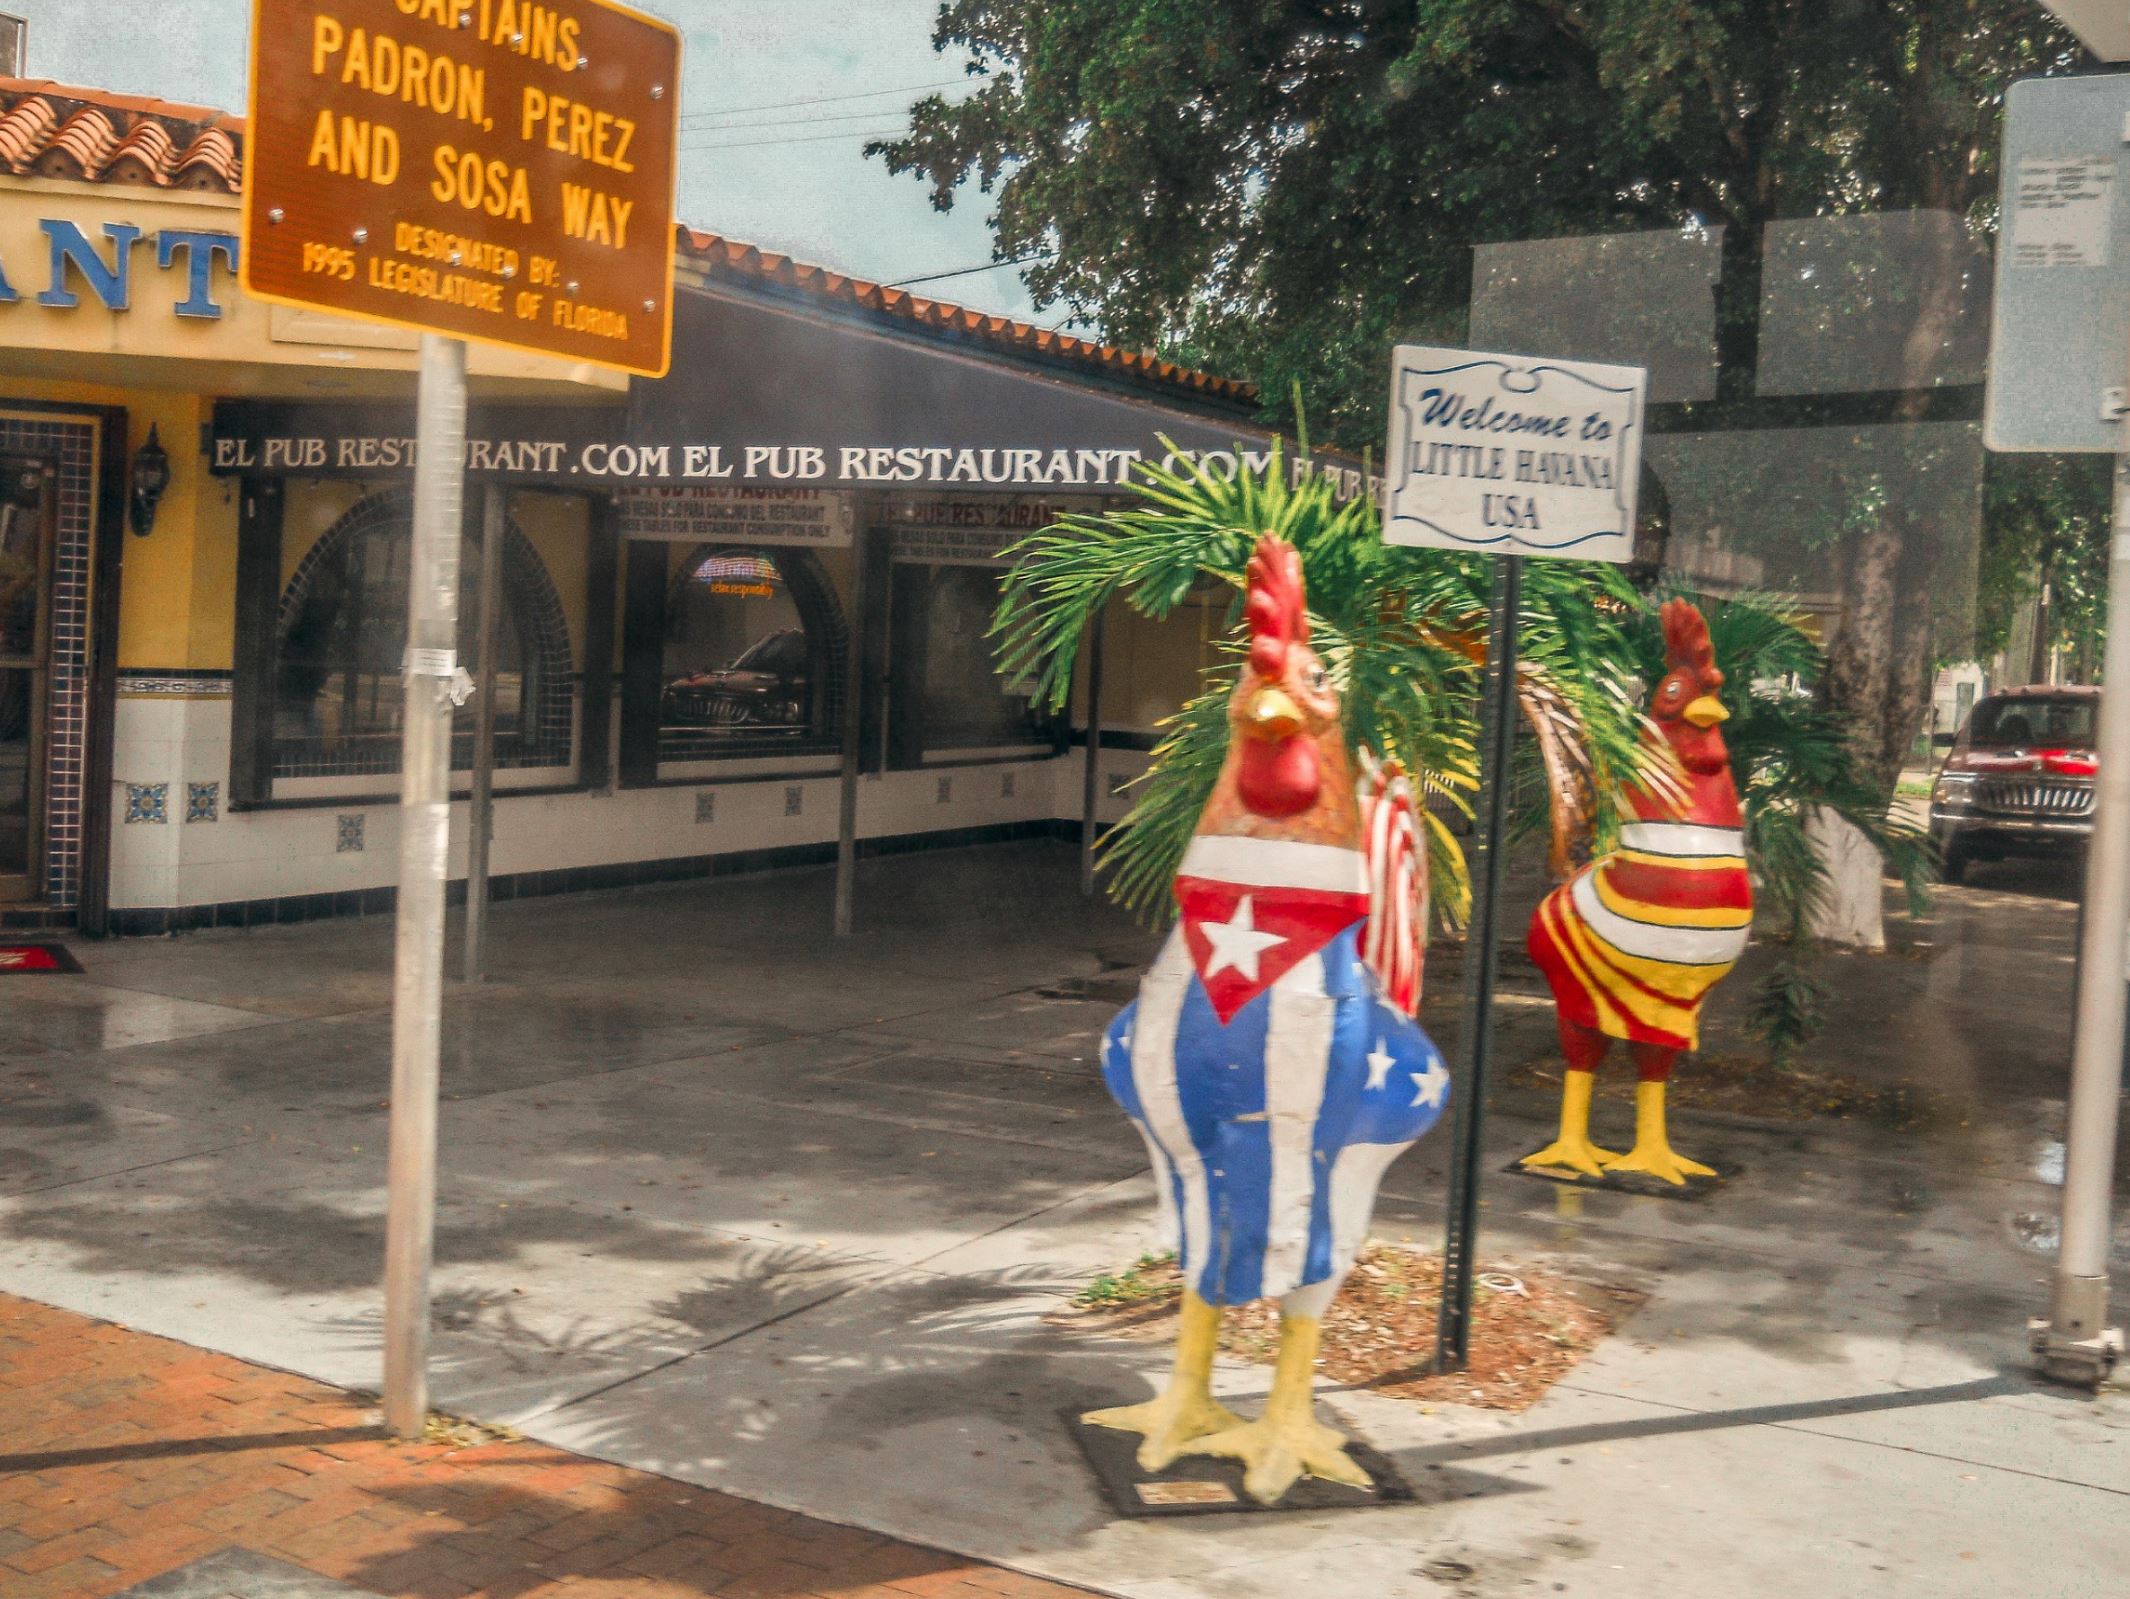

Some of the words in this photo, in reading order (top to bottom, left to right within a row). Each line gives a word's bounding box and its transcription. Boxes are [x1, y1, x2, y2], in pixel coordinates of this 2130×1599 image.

[396, 0, 581, 72] PTAINS
[312, 15, 494, 132] PADRON,
[522, 86, 636, 173] PEREZ
[308, 110, 400, 186] AND
[431, 145, 532, 224] SOSA
[562, 182, 634, 249] WAY
[0, 218, 241, 318] NT
[395, 222, 519, 277] DESIGNATED
[529, 256, 561, 288] BY:
[302, 242, 356, 281] 1995
[369, 257, 504, 313] LEGISLATURE
[516, 291, 544, 320] OF
[553, 300, 628, 340] FLORIDA
[1419, 388, 1571, 437] Welcome
[1580, 412, 1613, 441] to
[214, 439, 254, 467] EL
[264, 439, 327, 468] PUB
[337, 438, 567, 471] RESTRANT
[683, 446, 734, 478] EL
[743, 446, 826, 479] PUB
[1411, 441, 1506, 480] LITTLE
[1515, 450, 1617, 490] HAVANA
[1482, 493, 1540, 530] USA
